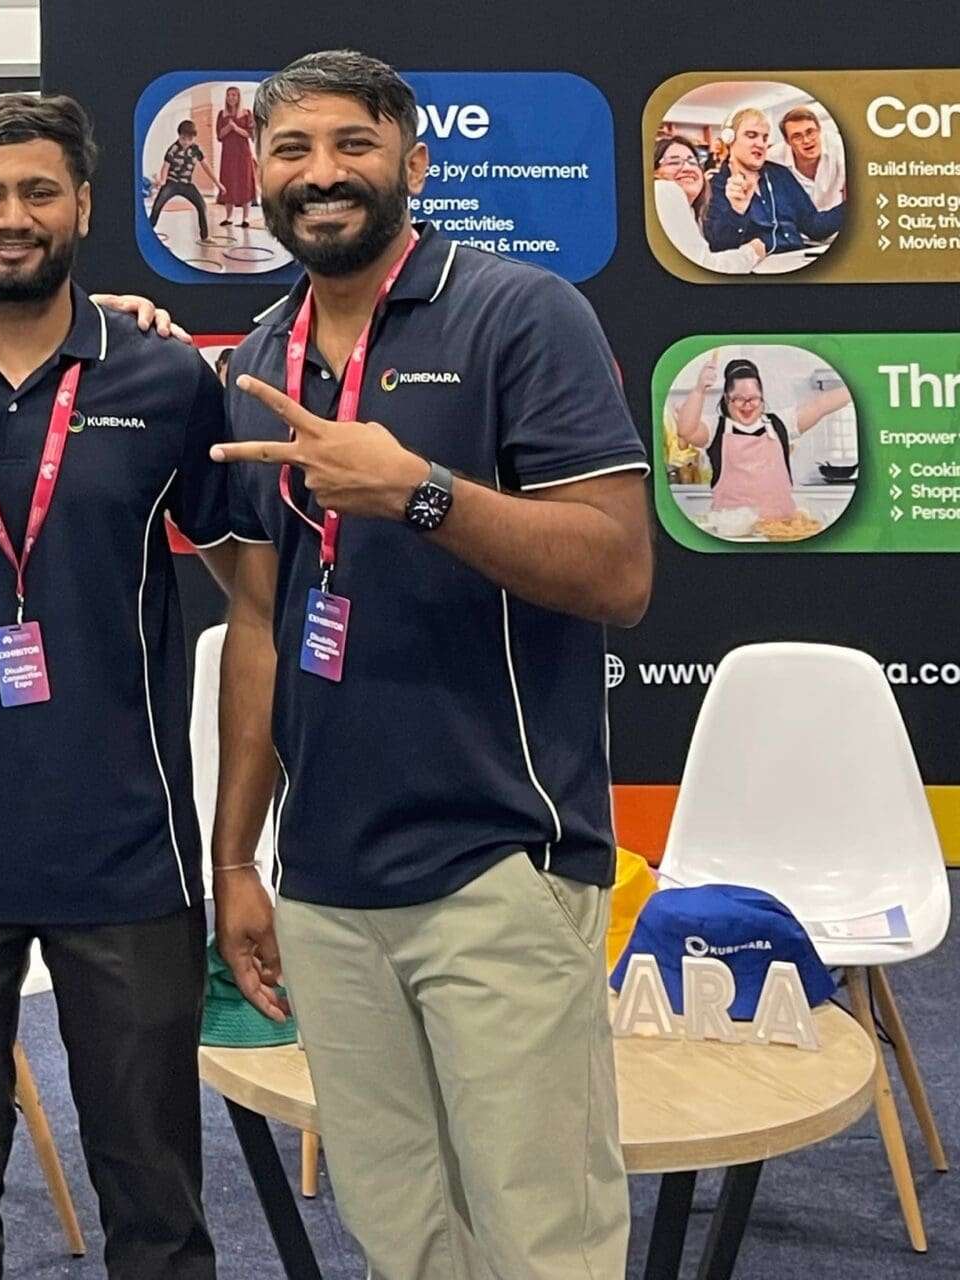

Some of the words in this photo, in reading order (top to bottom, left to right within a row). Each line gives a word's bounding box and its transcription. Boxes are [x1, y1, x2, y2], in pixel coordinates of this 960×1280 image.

[416, 104, 490, 139] ve
[442, 161, 470, 182] joy
[472, 161, 489, 178] of
[492, 163, 590, 180] movement
[867, 161, 907, 176] Build
[423, 197, 480, 215] games
[897, 192, 946, 208] Board
[445, 216, 515, 232] activities
[898, 213, 937, 231] Quiz,
[497, 238, 511, 252] &
[513, 240, 561, 252] more.
[899, 234, 948, 250] Movie
[880, 429, 957, 449] Empower
[881, 663, 960, 685] a.co
